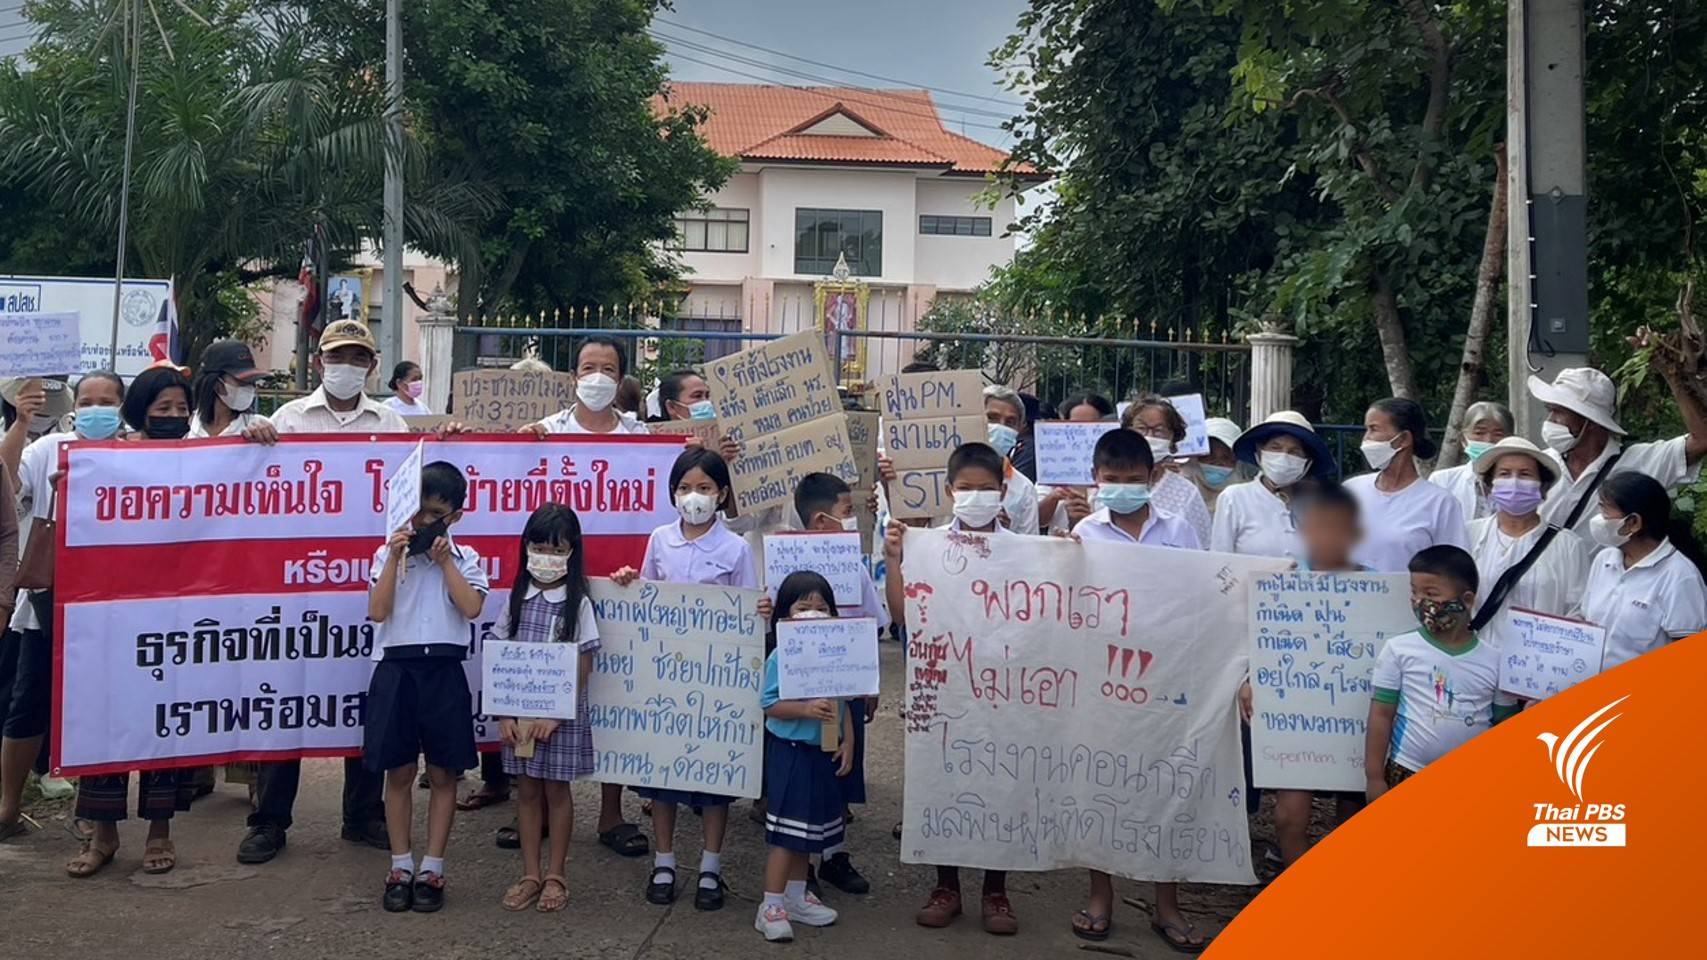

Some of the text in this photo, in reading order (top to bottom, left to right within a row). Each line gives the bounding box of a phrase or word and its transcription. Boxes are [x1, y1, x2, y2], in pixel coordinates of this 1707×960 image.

[95, 460, 343, 521] ขอความเห็นใจ
[902, 471, 947, 508] ST
[971, 579, 1128, 636] พวกเรา
